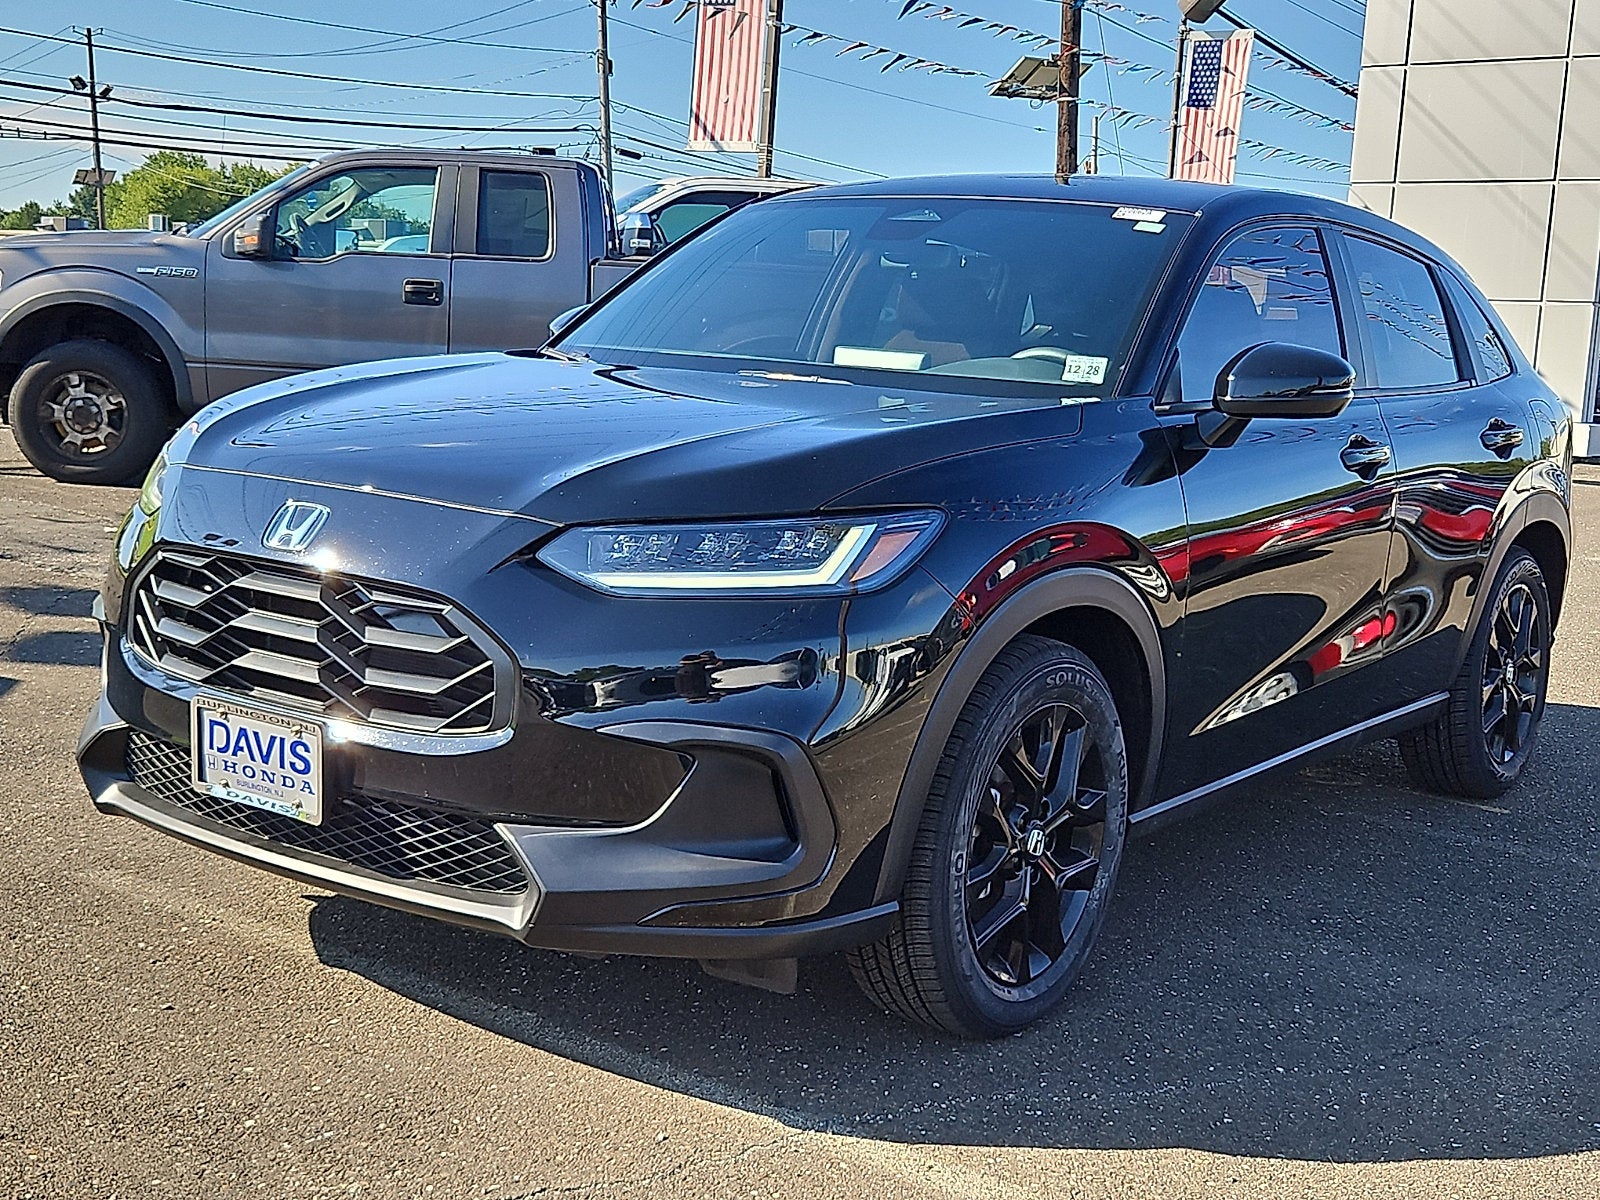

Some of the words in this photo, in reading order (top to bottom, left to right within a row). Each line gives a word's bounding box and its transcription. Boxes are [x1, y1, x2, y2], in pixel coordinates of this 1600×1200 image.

[1067, 365, 1081, 373] 12
[1086, 366, 1100, 375] 28
[1046, 671, 1094, 692] SOLUS
[208, 719, 312, 775] DAVIS
[222, 759, 316, 795] HONDA
[226, 789, 292, 813] DAVIS
